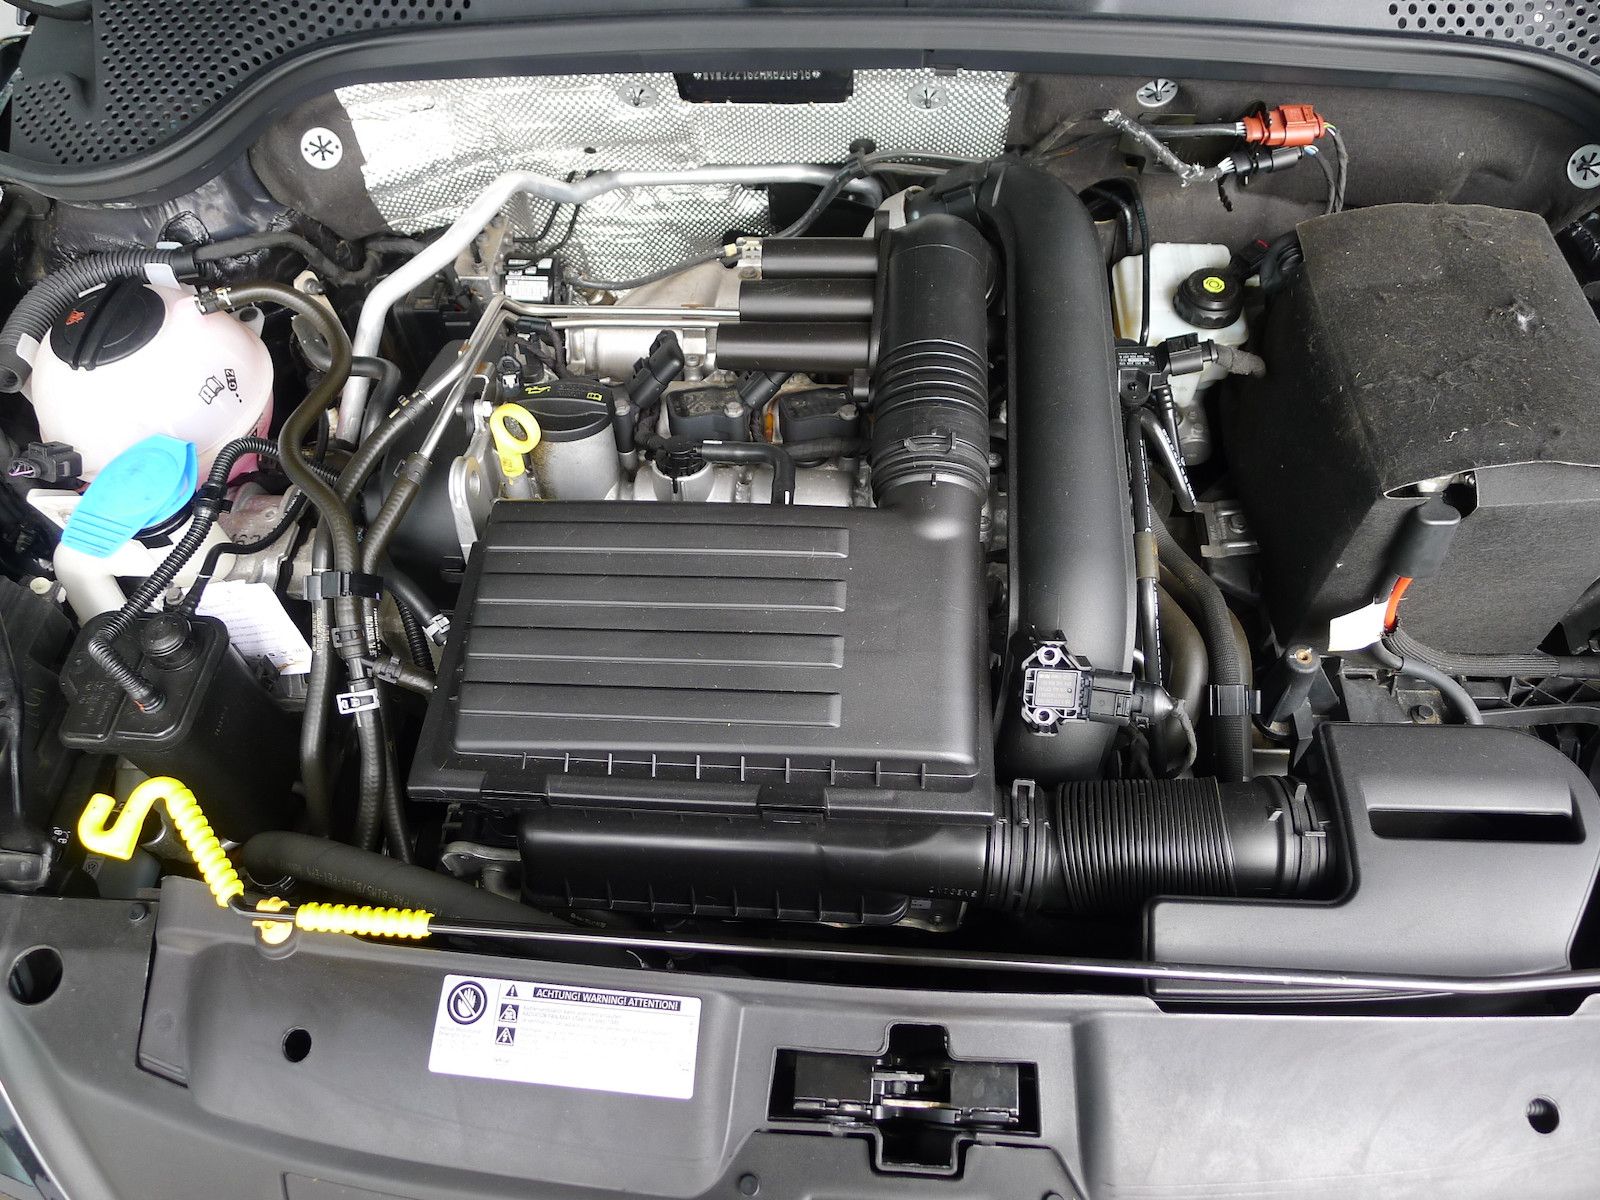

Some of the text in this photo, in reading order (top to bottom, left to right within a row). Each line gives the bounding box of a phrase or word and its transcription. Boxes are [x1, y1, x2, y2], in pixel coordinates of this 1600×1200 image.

[535, 988, 581, 1002] ACHTUNG!
[582, 992, 628, 1006] WARNING!
[628, 998, 679, 1011] ATTENTION!
